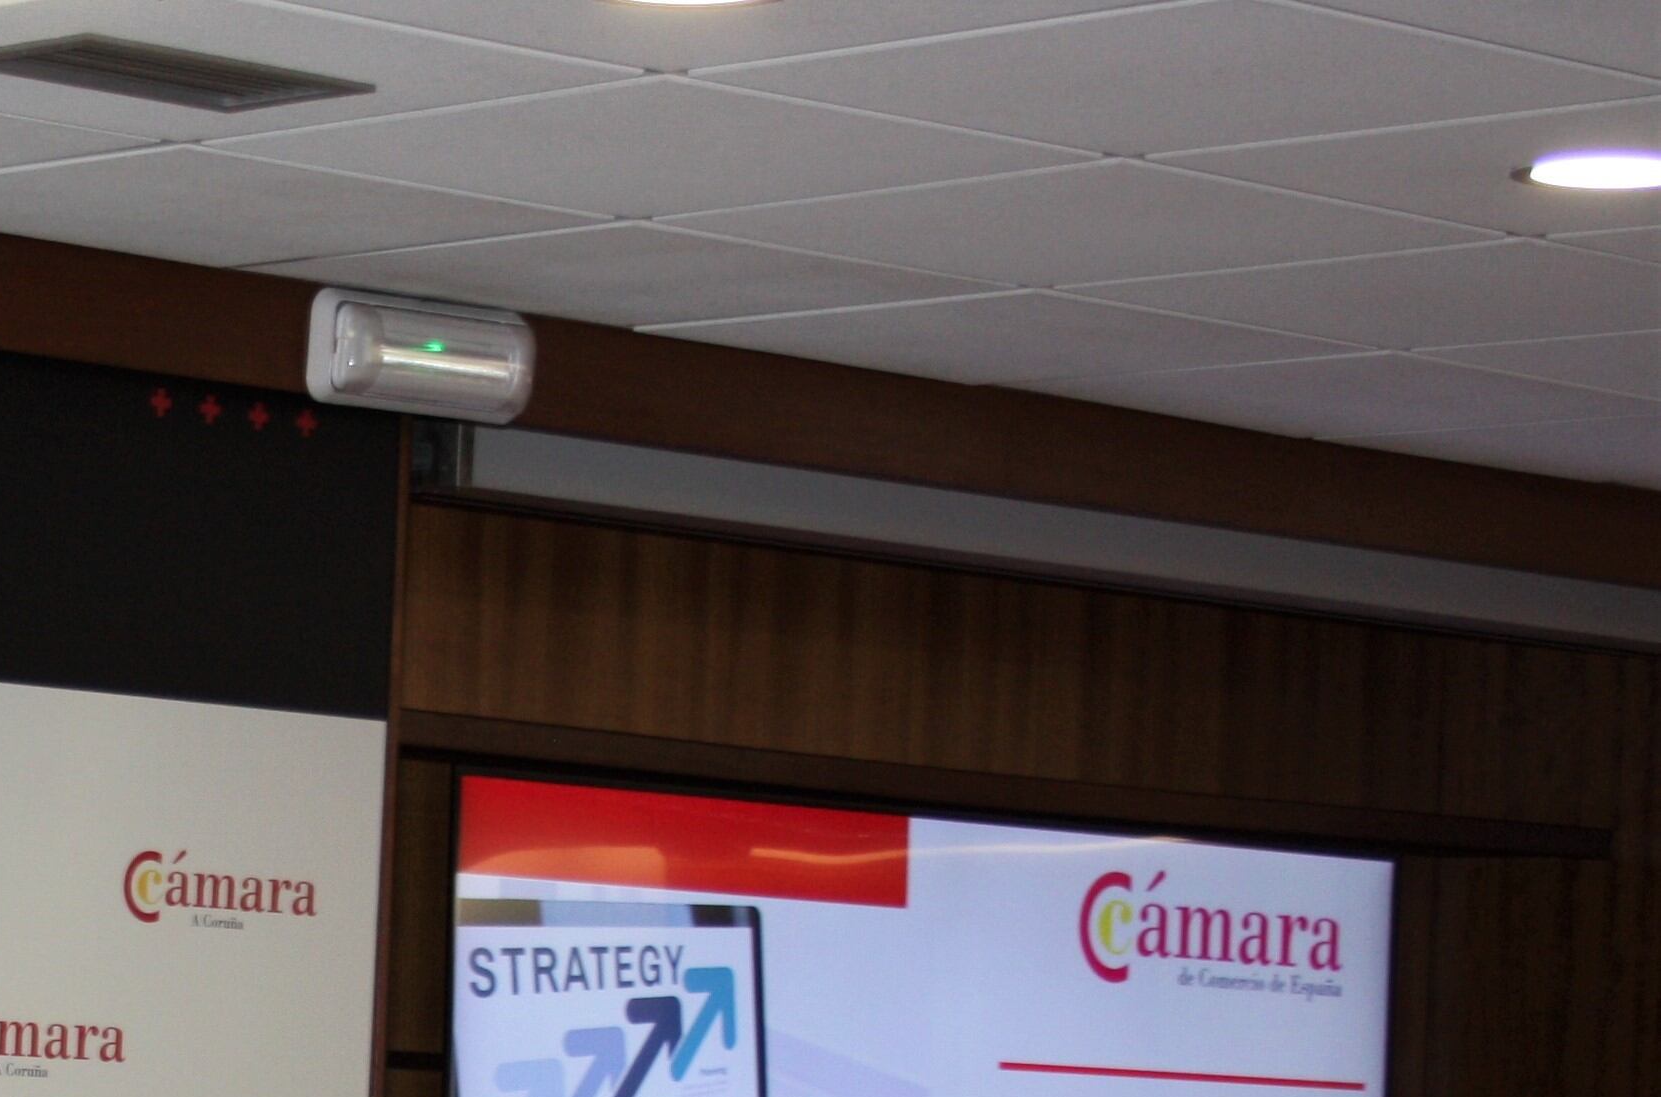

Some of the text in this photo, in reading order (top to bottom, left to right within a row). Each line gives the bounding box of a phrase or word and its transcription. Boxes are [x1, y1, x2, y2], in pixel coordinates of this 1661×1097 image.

[192, 914, 244, 930] A Coruña
[469, 945, 683, 998] STRATEGY
[1178, 967, 1343, 1001] de Comercio de España
[5, 1063, 49, 1078] Coruña
